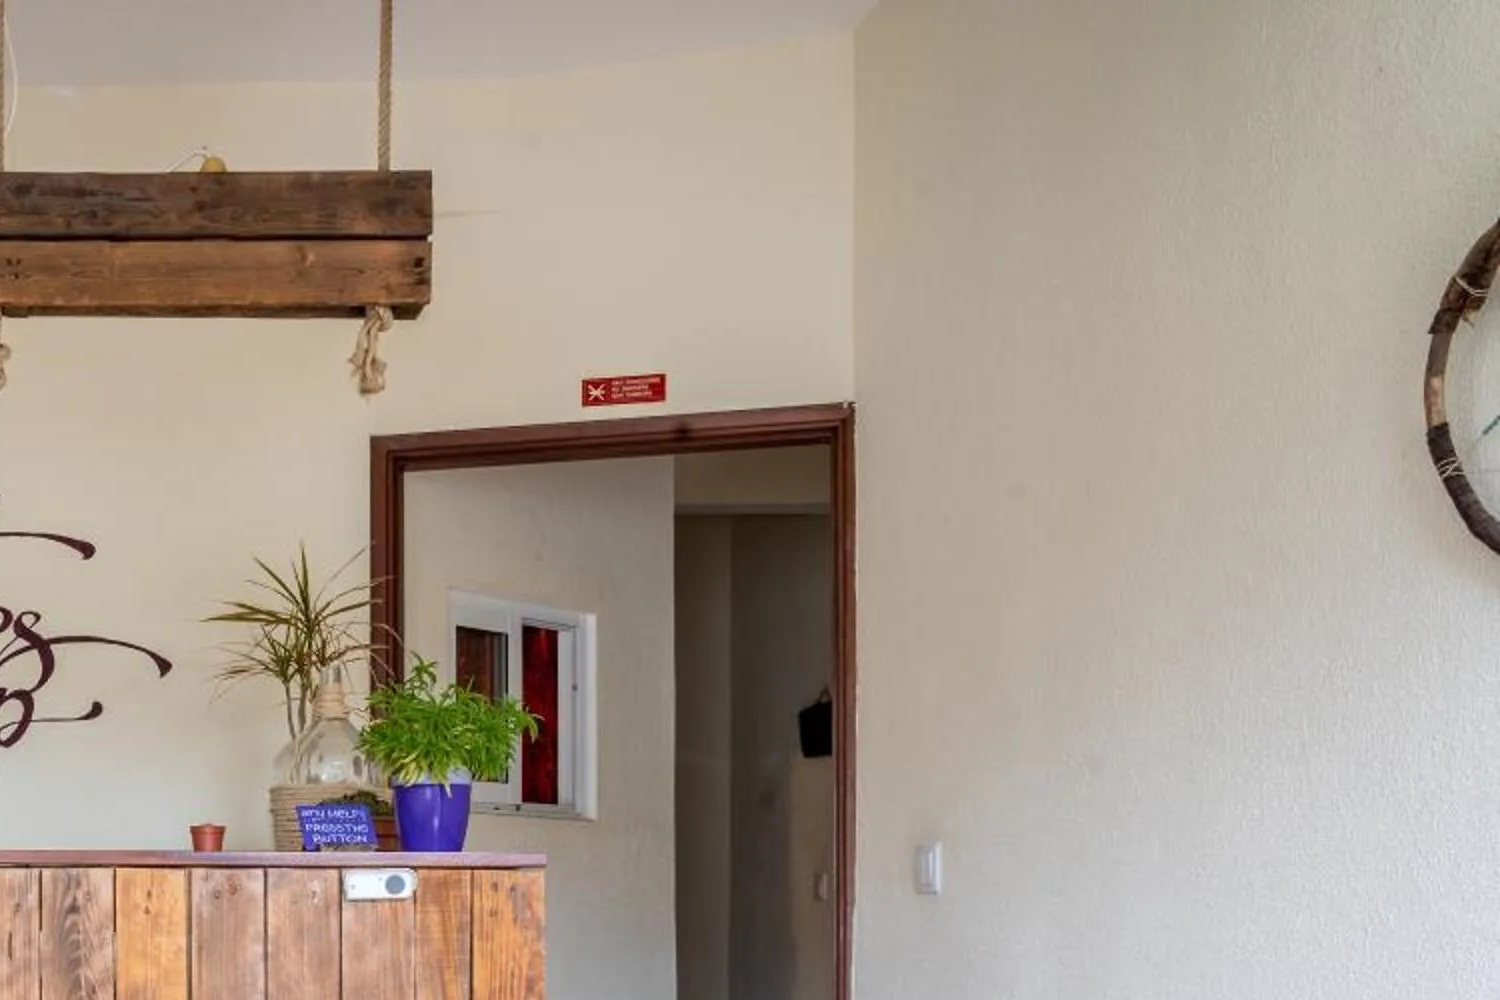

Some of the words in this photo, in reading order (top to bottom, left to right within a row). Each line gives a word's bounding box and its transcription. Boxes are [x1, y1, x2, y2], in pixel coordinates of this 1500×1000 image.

[305, 823, 345, 833] PRESS
[343, 823, 368, 833] THE
[312, 832, 368, 844] BUTTON
